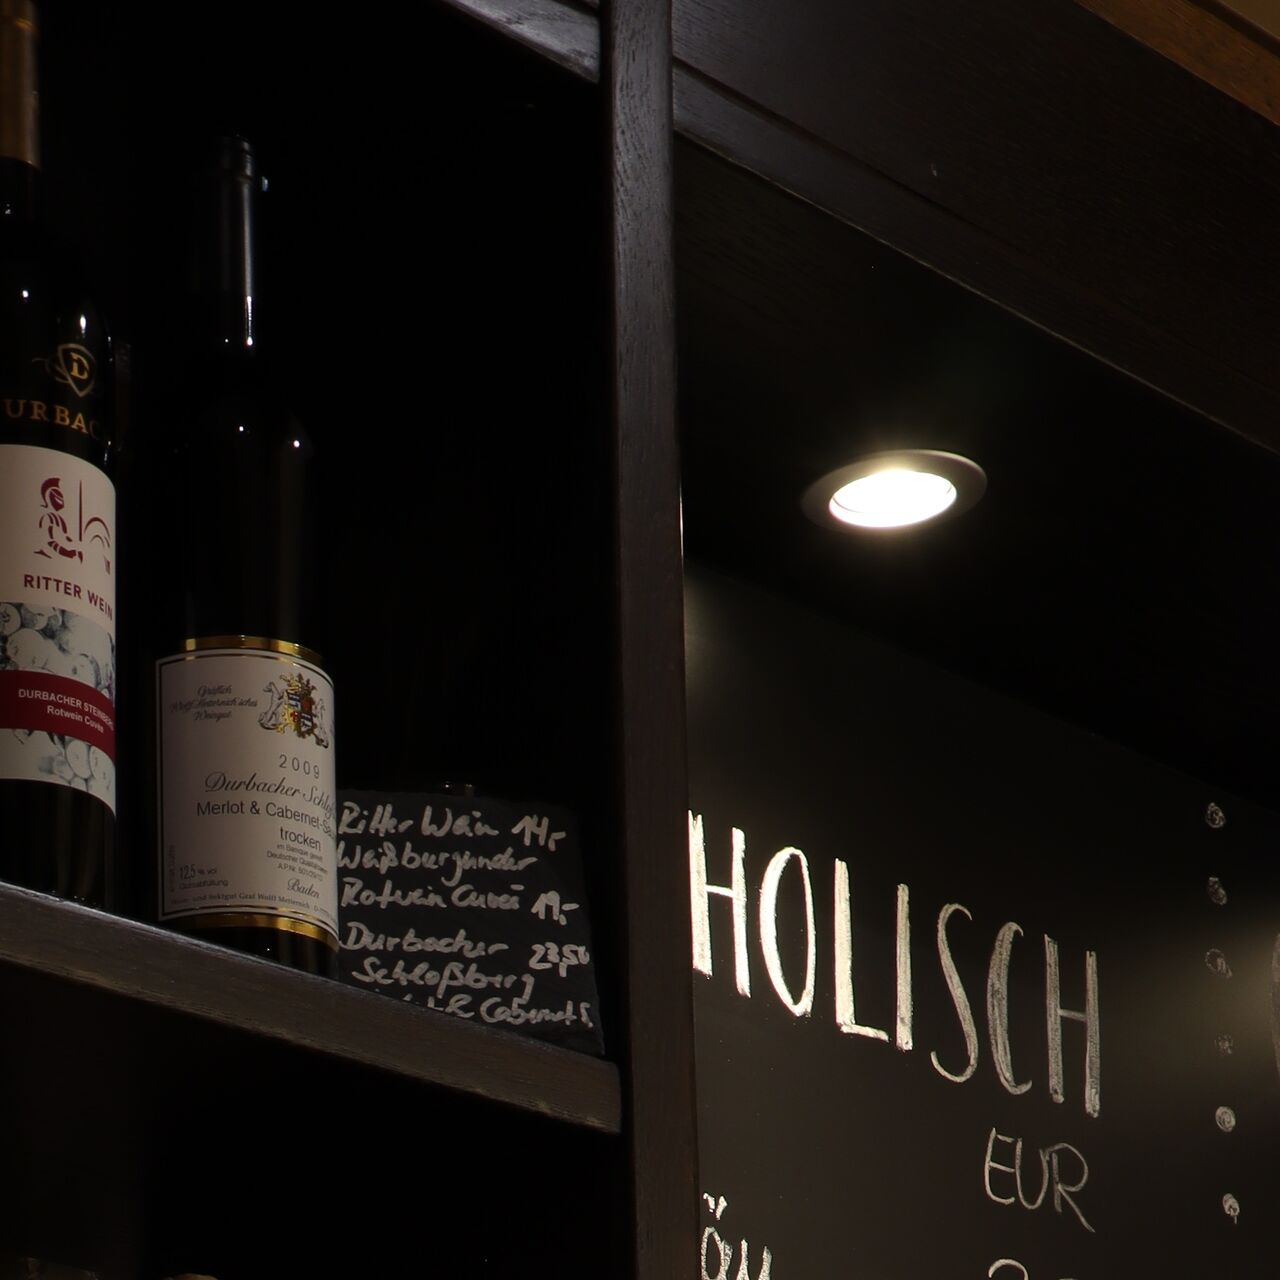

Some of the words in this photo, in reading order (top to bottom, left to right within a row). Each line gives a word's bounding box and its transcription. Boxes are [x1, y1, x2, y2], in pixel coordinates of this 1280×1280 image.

[23, 573, 83, 600] RITTER
[87, 589, 113, 621] WEIN
[18, 688, 83, 710] DURBACHER
[46, 704, 84, 723] Rotwein
[278, 753, 321, 780] 2009
[204, 770, 302, 798] Durbacher
[196, 799, 246, 818] Merlot
[249, 800, 261, 816] &
[421, 804, 500, 838] Wein
[279, 826, 322, 852] trocken
[287, 877, 321, 900] Baden
[340, 877, 448, 909] Rotwein
[687, 808, 1102, 1119] HOLISCH
[983, 1126, 1096, 1234] EUR
